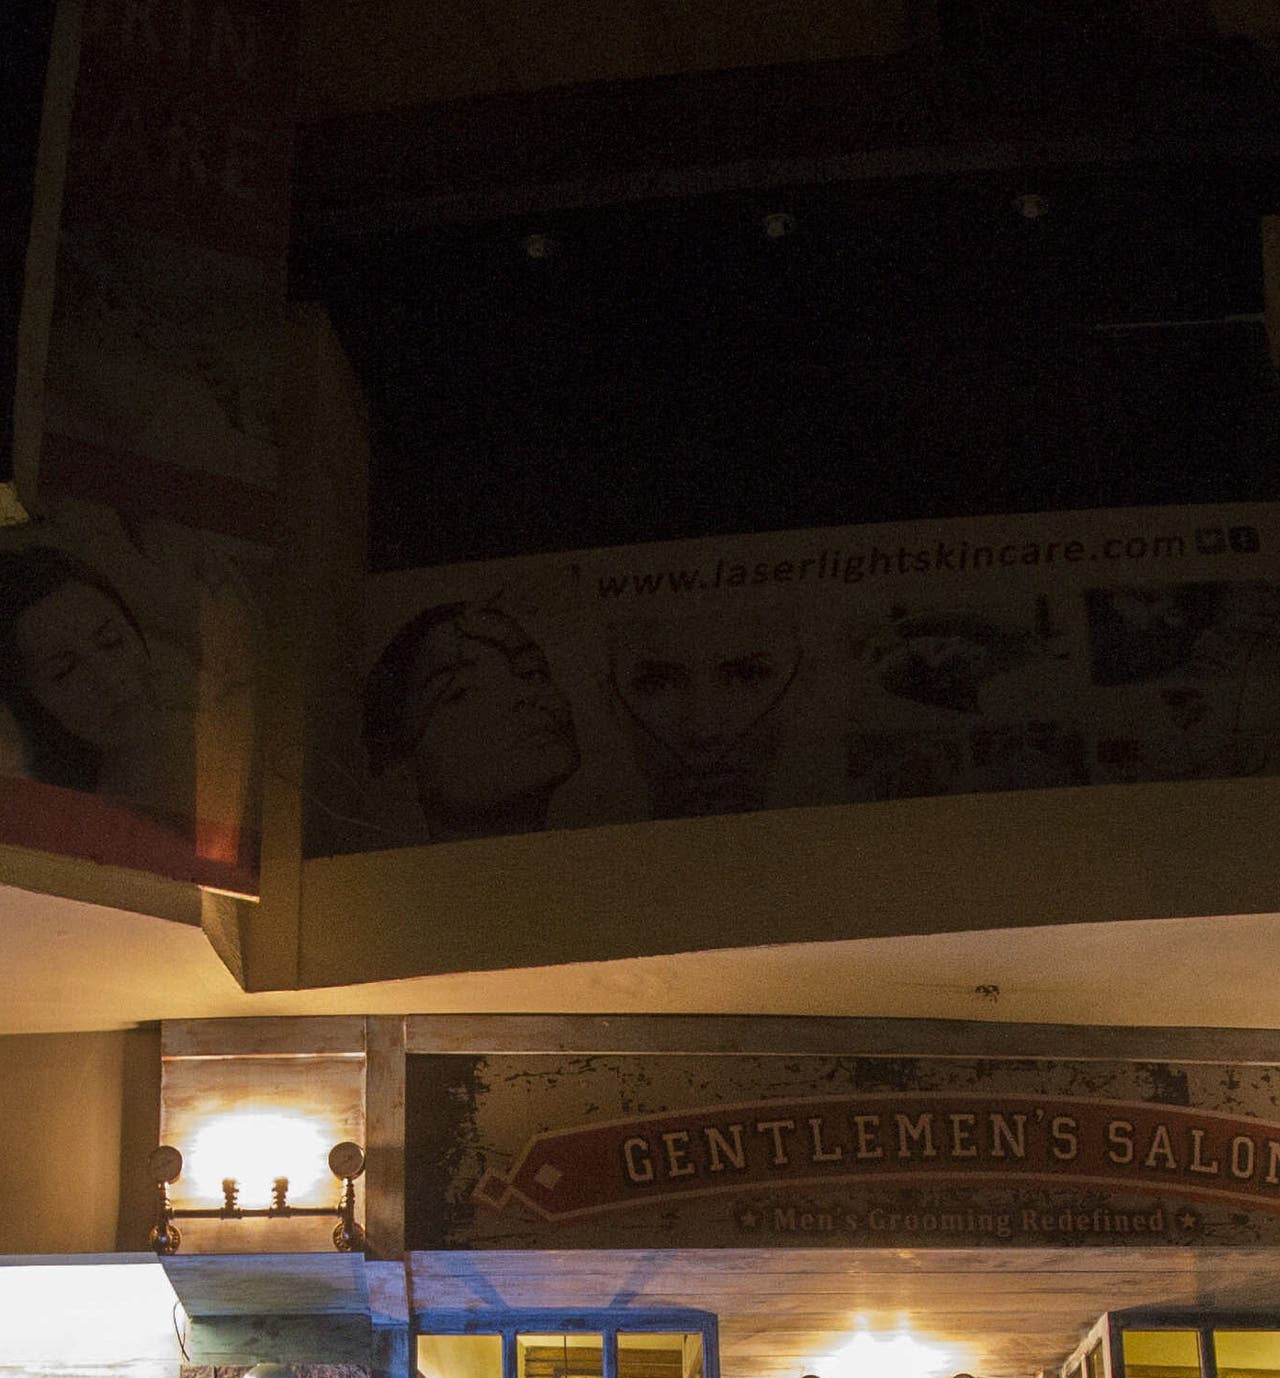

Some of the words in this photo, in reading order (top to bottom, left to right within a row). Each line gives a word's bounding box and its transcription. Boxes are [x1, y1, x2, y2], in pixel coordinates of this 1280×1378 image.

[597, 530, 1187, 600] www.laserlightskincare.com
[623, 1109, 1078, 1183] GENTLEMEN'S
[773, 1206, 858, 1231] Men's
[869, 1206, 1012, 1237] Grooming
[1022, 1207, 1165, 1232] Redefined
